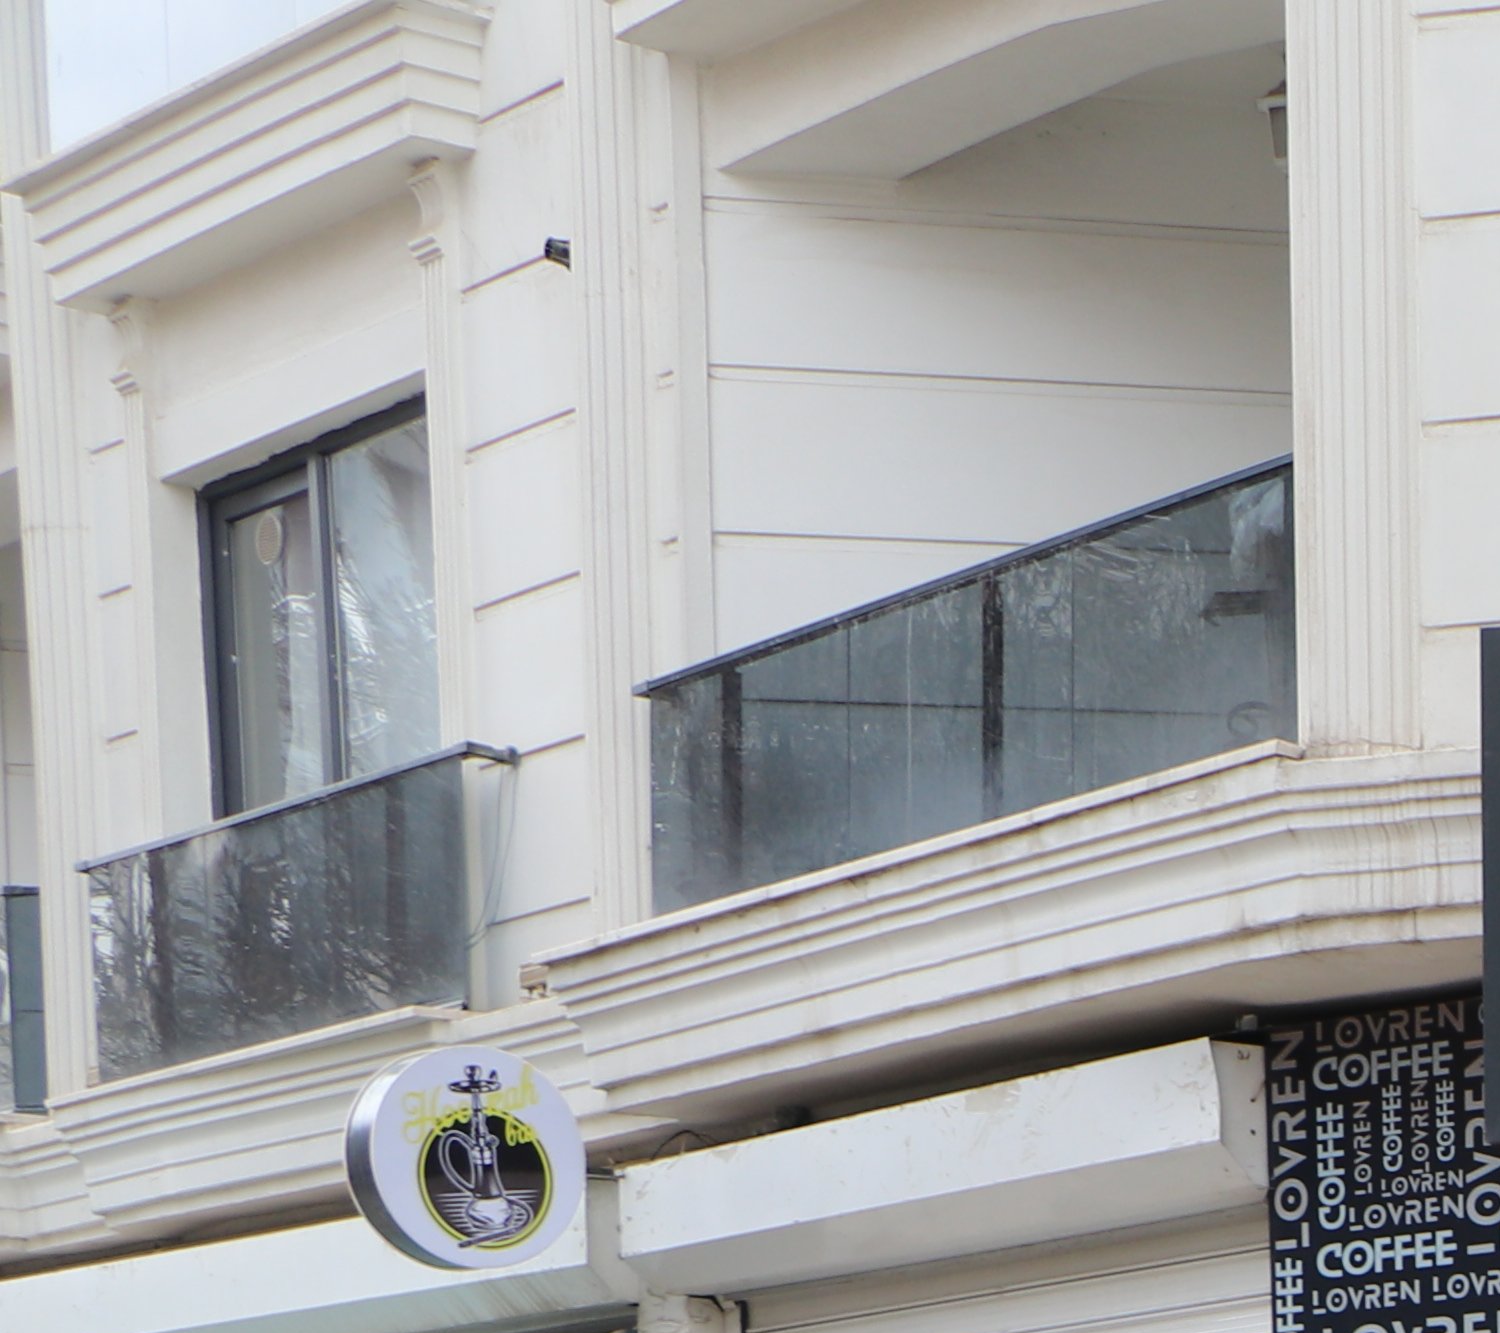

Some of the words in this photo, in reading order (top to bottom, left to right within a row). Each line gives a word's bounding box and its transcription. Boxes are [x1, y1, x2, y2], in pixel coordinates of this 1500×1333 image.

[1315, 1000, 1465, 1053] LOVREN
[1312, 1041, 1454, 1091] COFFEE
[1270, 1030, 1310, 1252] LOVREN
[1382, 1084, 1403, 1172] COFFEE
[1436, 1080, 1455, 1162] COFFEE
[1316, 1102, 1346, 1230] COFFEE
[1381, 1169, 1464, 1197] LOVREN
[1349, 1194, 1465, 1232] LOVREN
[1316, 1230, 1458, 1279] COFFEE
[1312, 1278, 1421, 1315] LOVREN
